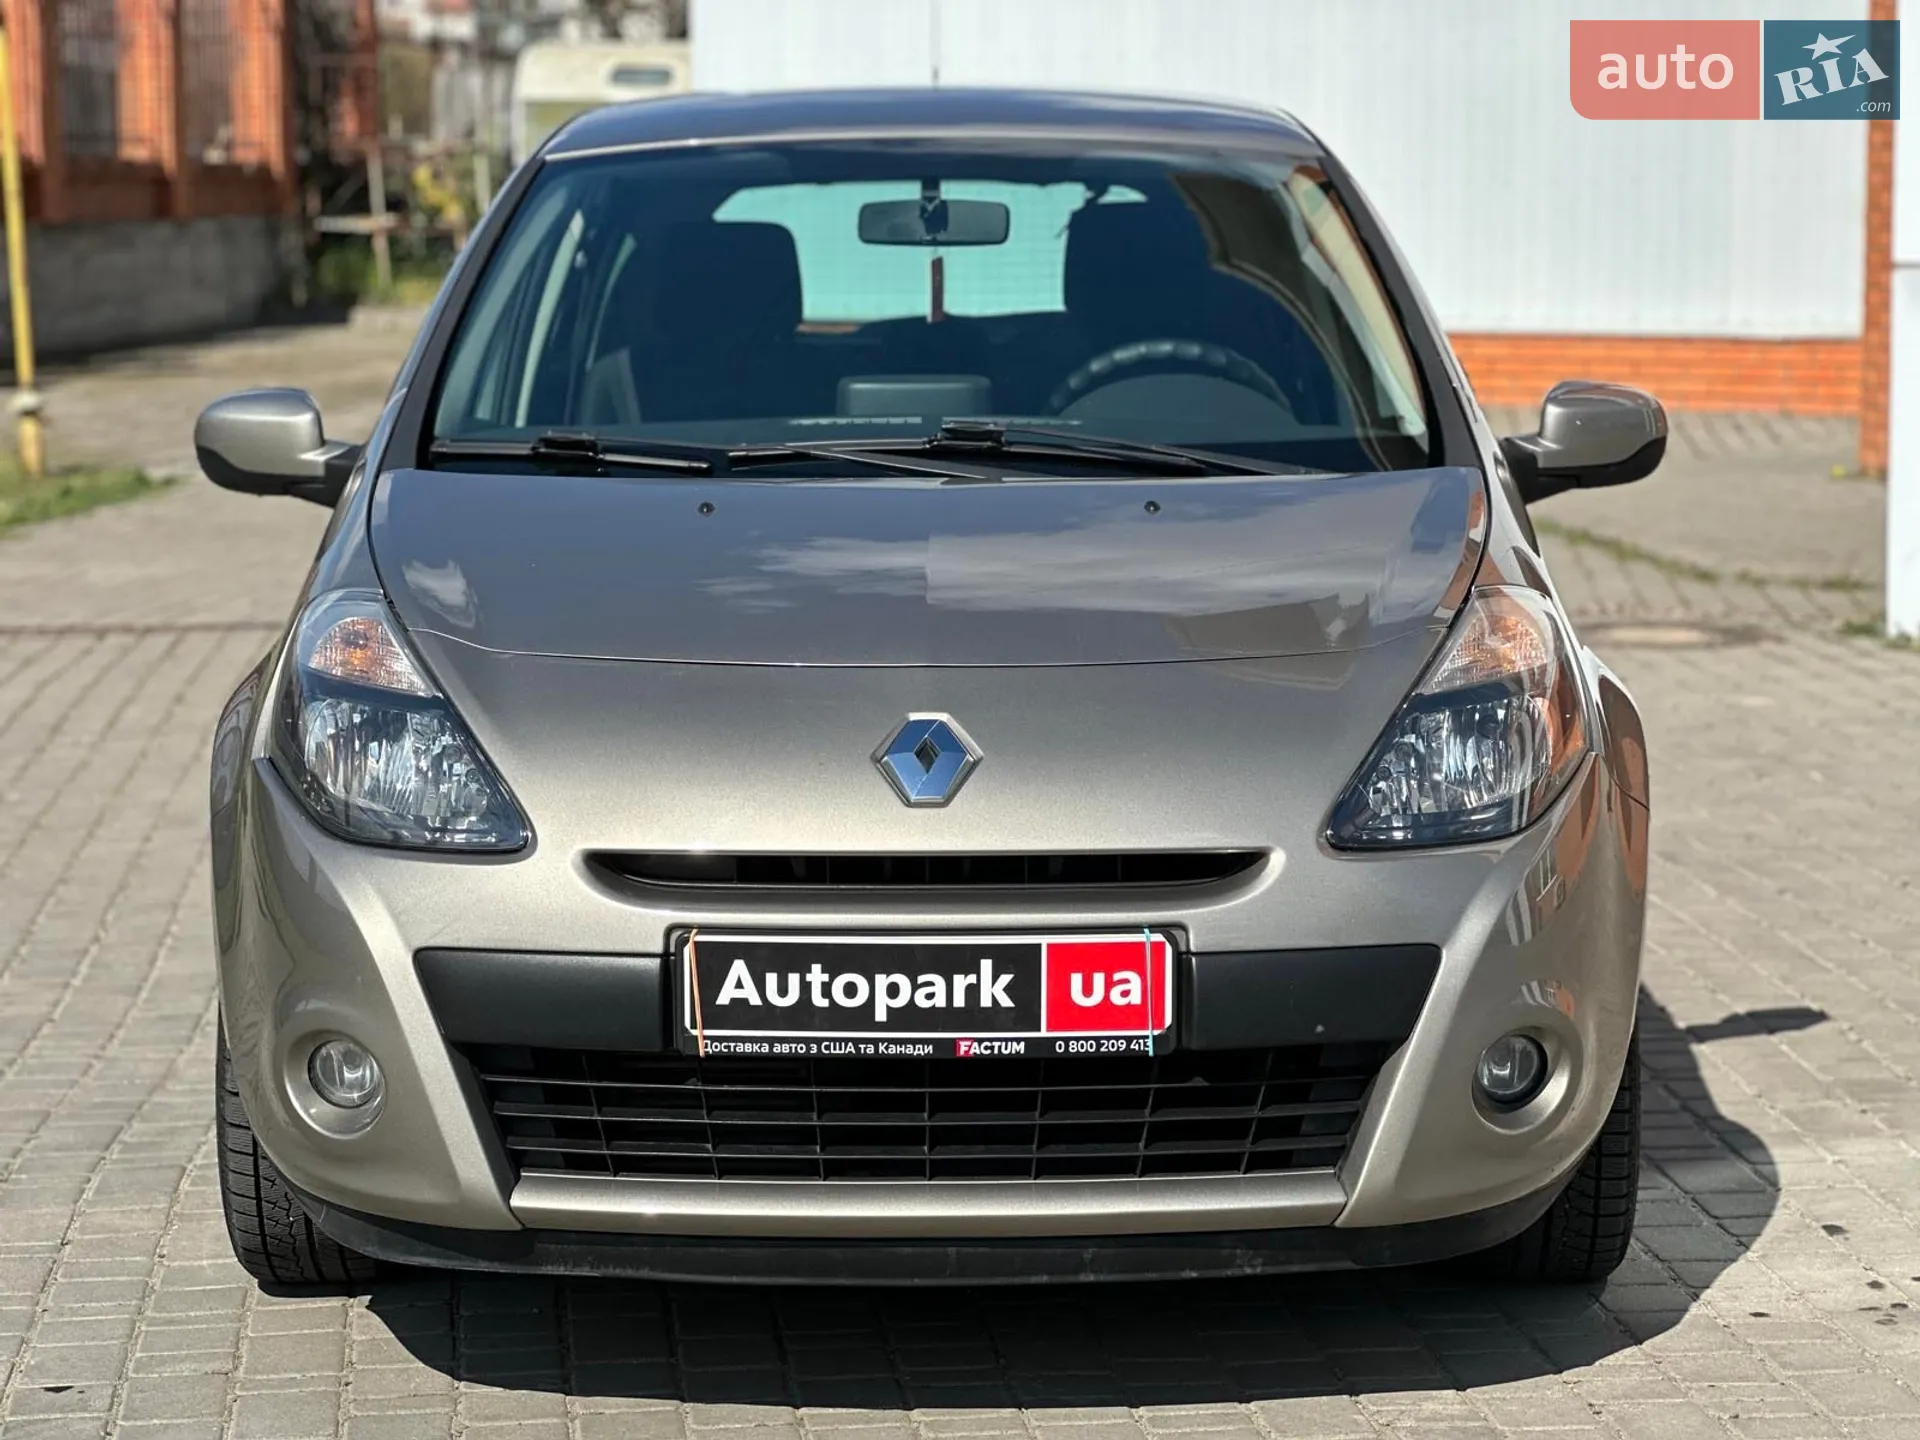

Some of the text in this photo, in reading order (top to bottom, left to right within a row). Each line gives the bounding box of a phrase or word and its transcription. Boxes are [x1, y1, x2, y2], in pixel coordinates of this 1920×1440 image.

[715, 958, 1143, 1022] Autopark ua
[703, 1040, 934, 1056] Доставка авто з США та Канади
[959, 1041, 1025, 1055] FACTUM
[1055, 1040, 1065, 1052] 0
[1069, 1040, 1096, 1052] 800
[1100, 1039, 1126, 1051] 209
